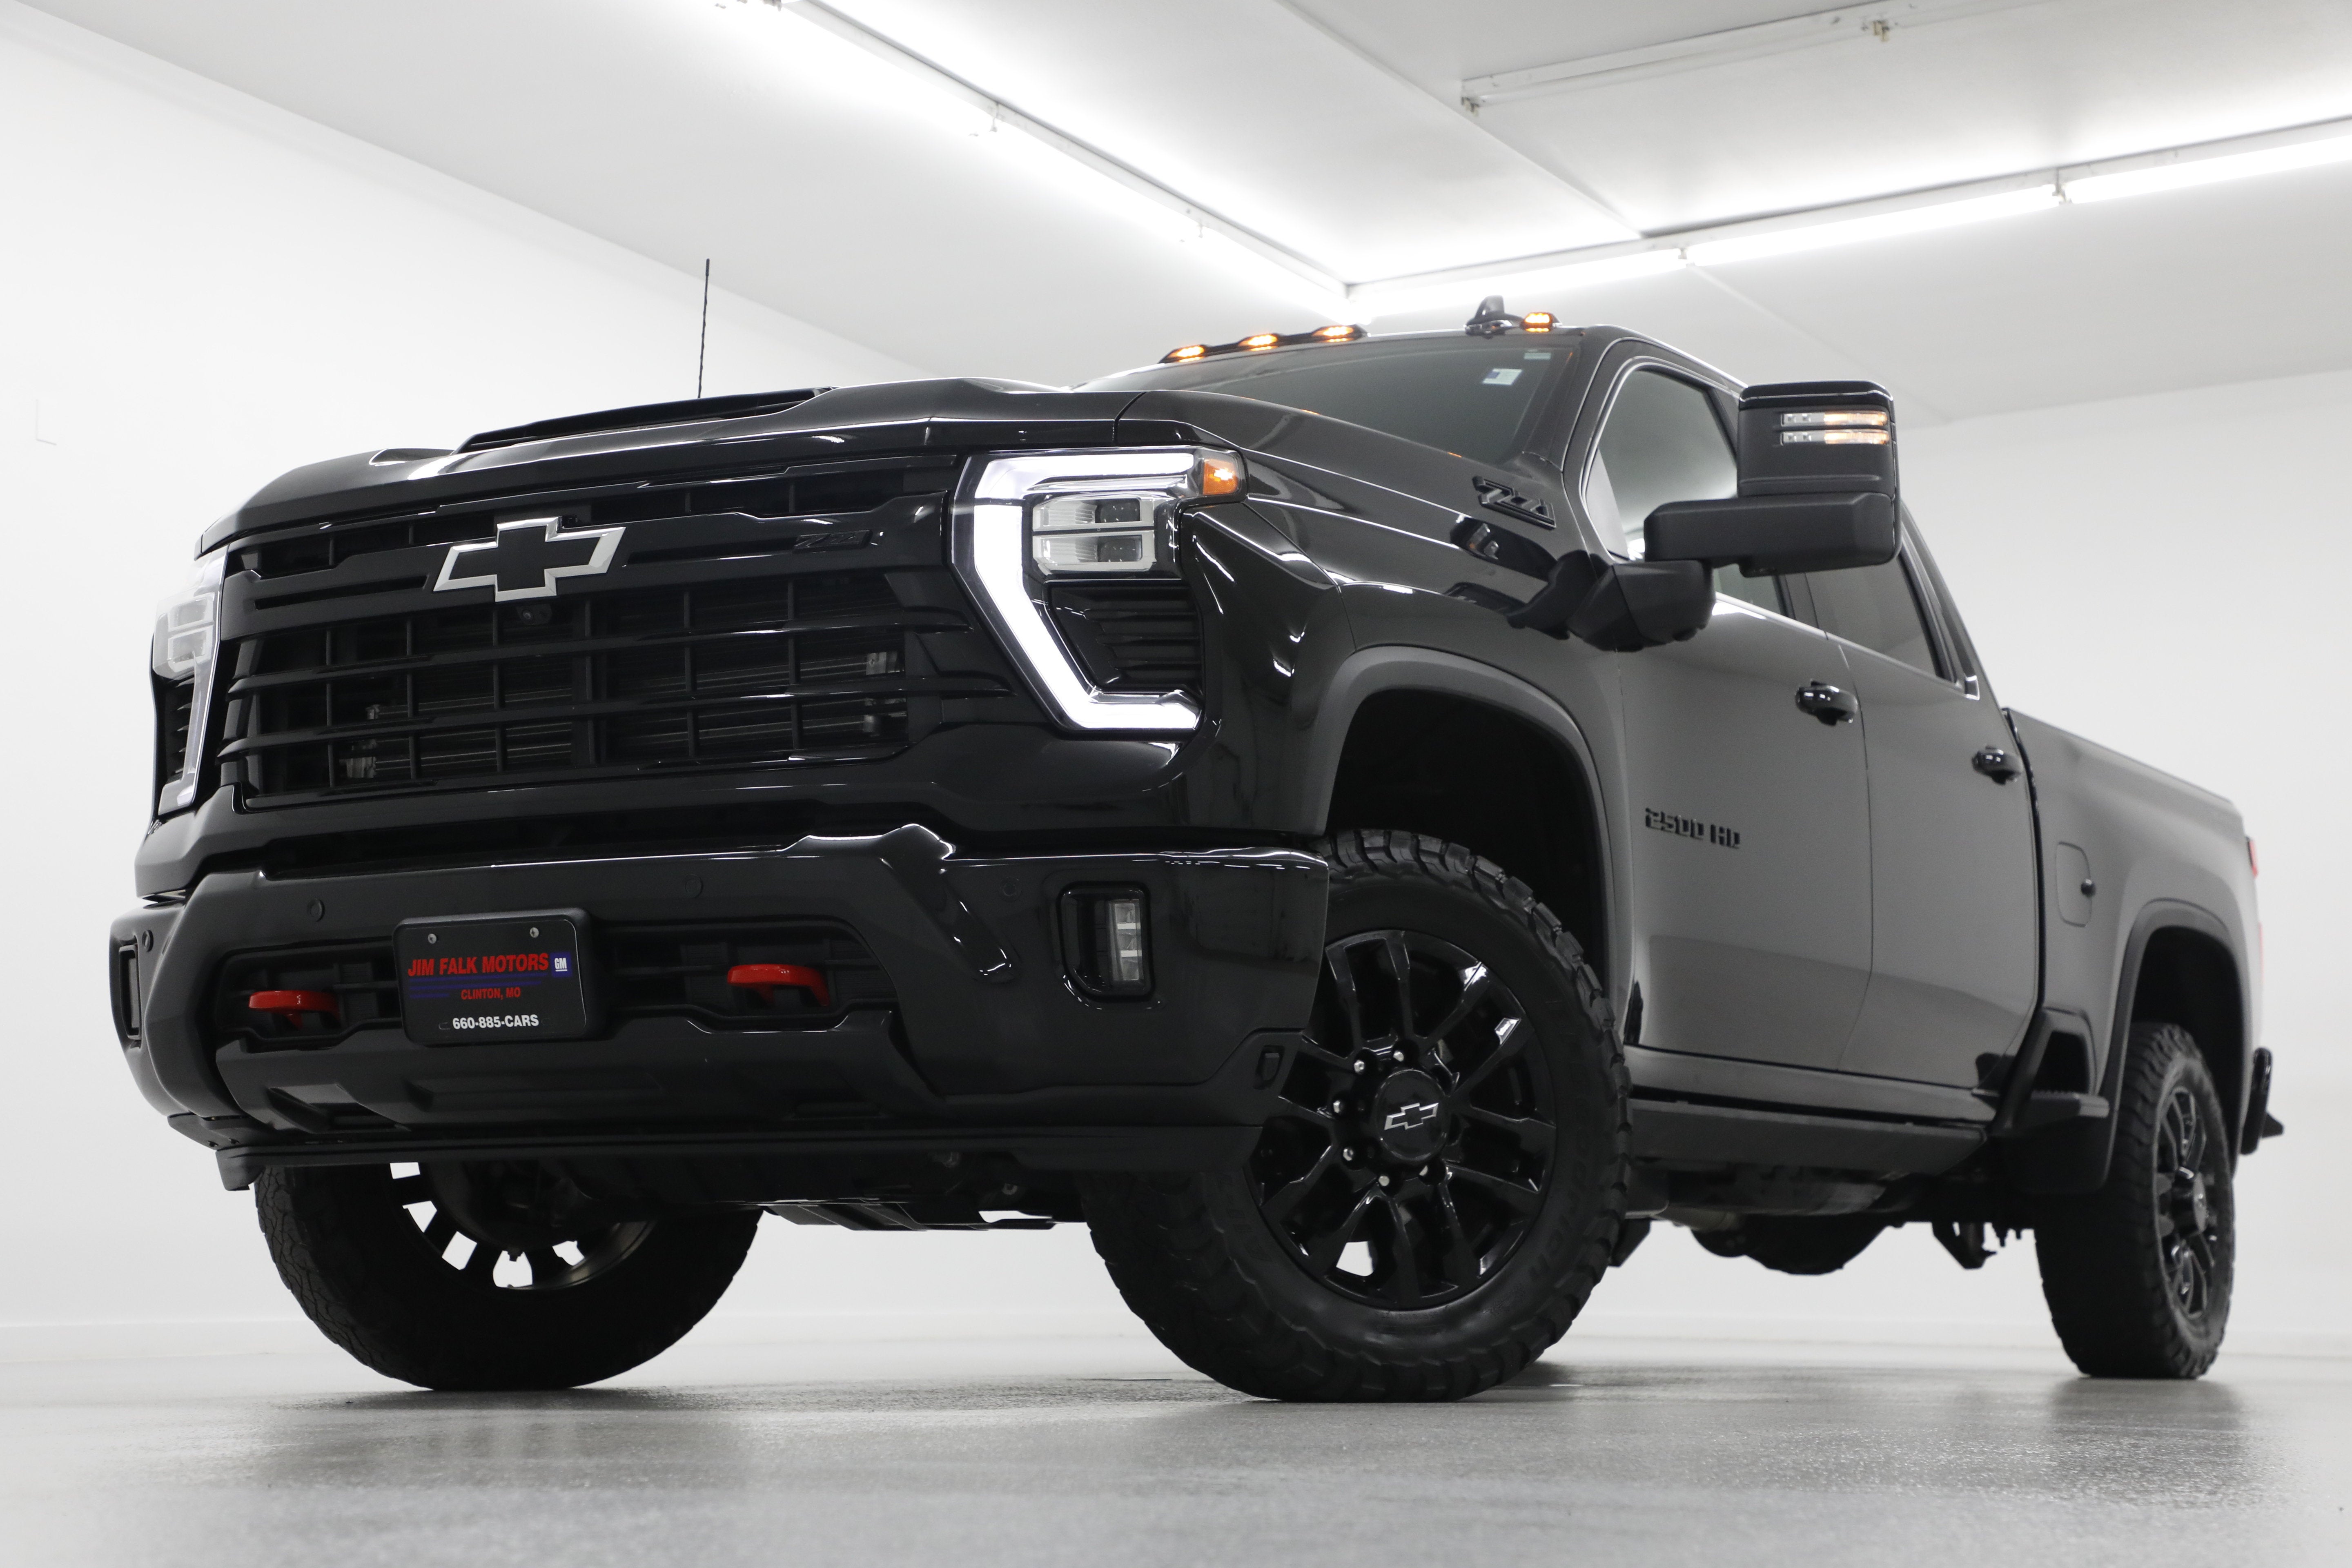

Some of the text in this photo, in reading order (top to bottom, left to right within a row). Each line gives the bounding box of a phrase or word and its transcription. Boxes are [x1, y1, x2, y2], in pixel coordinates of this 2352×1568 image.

[1645, 807, 1740, 849] 2500 HD
[408, 952, 549, 977] JIM FALK MOTORS
[554, 958, 568, 972] GM
[461, 987, 521, 1000] CLINTON, MO
[452, 1014, 539, 1029] 660-885-CARS
